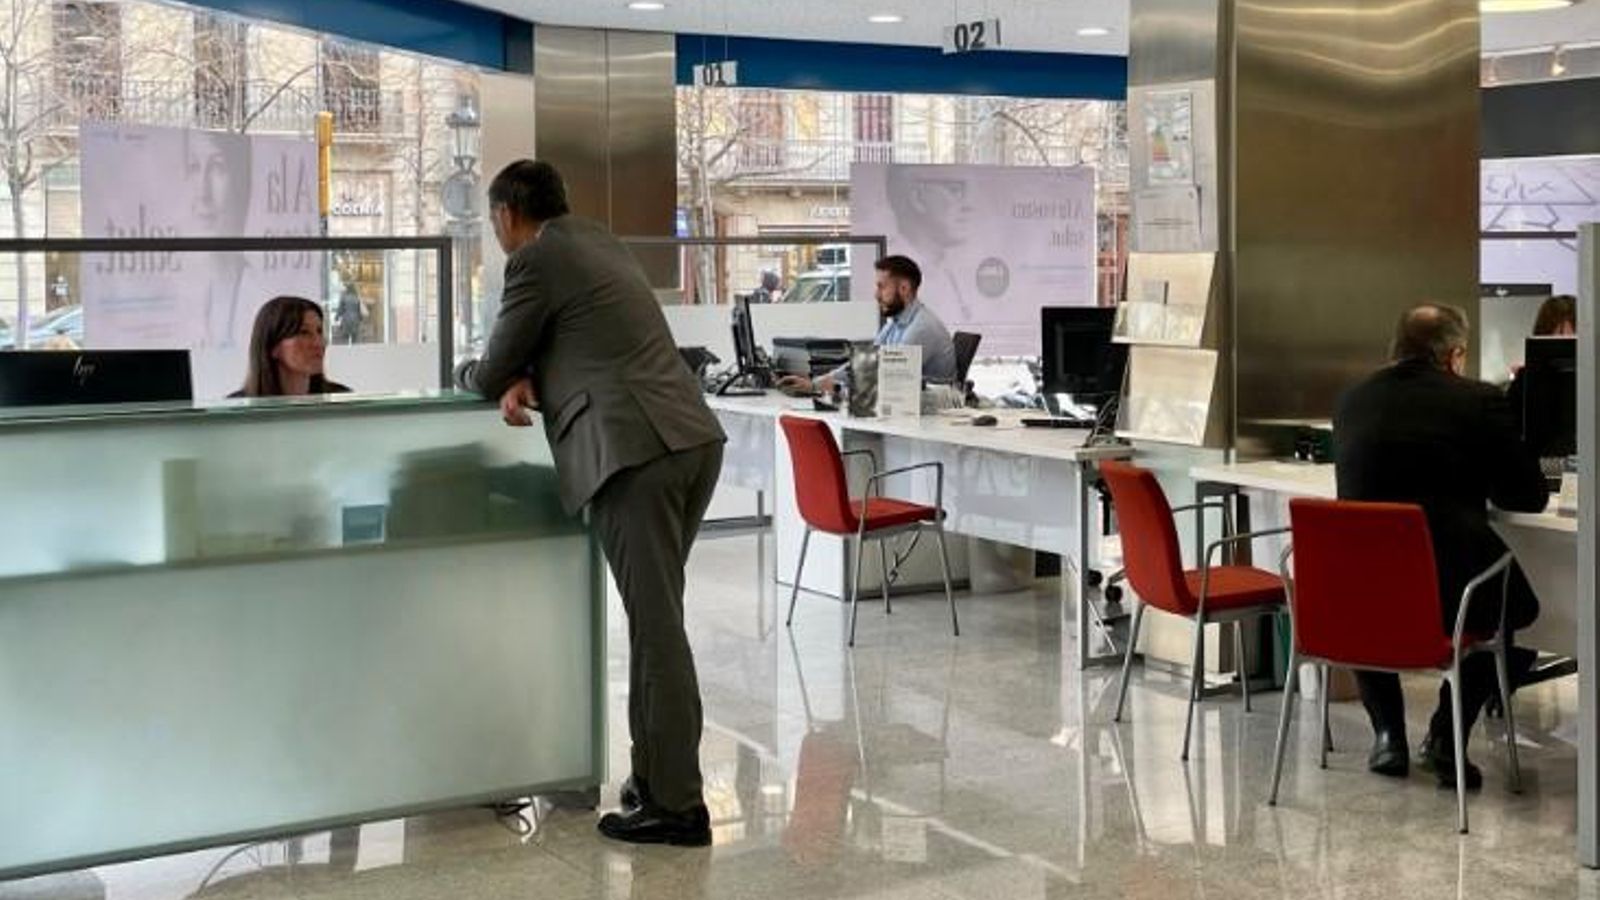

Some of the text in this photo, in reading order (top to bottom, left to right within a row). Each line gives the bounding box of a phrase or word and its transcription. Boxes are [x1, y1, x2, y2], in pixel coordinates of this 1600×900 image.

[954, 21, 986, 51] 02
[703, 63, 726, 87] 01
[73, 355, 96, 387] hp
